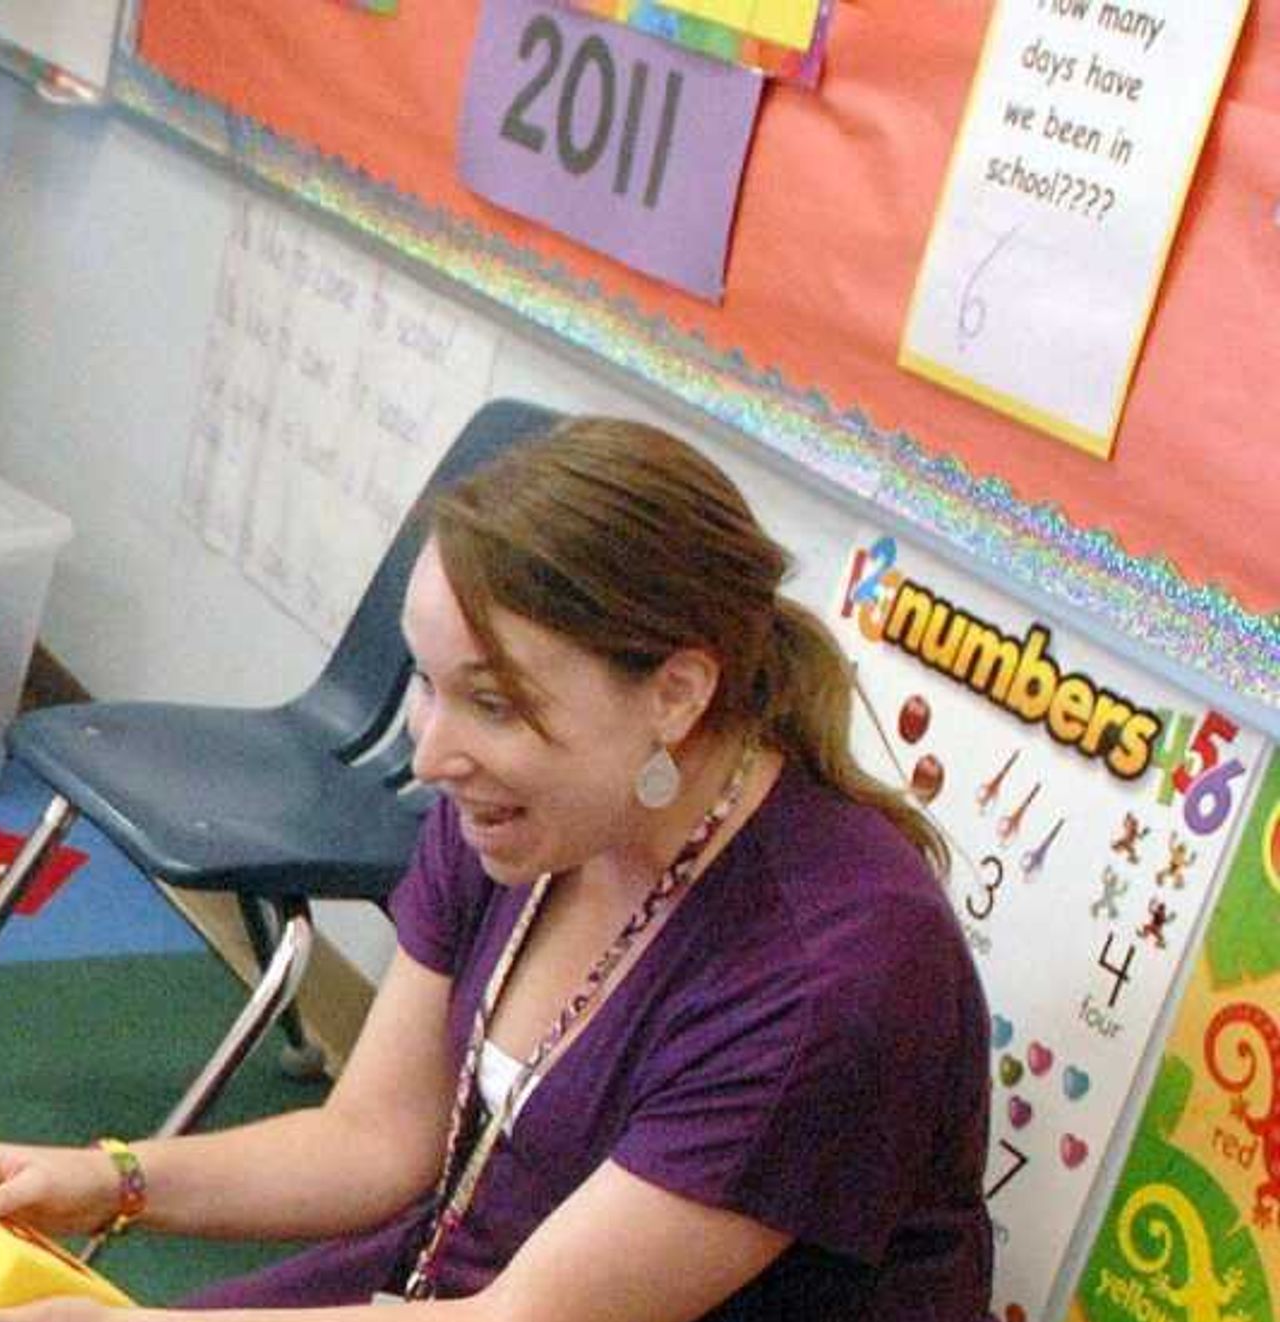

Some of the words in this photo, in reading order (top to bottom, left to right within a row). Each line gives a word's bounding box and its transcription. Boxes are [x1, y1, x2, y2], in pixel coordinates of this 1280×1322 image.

[1097, 2, 1167, 53] many
[1020, 37, 1078, 86] days
[1084, 52, 1145, 101] have
[499, 15, 684, 209] 2011
[1003, 100, 1036, 131] we
[1042, 104, 1102, 154] been
[1109, 126, 1133, 165] in
[985, 155, 1117, 222] school????
[882, 577, 1163, 781] numbers
[965, 854, 1003, 921] 3
[1098, 930, 1136, 1008] 4
[1078, 993, 1124, 1039] four
[984, 1138, 1028, 1199] 7
[1211, 1126, 1260, 1172] red
